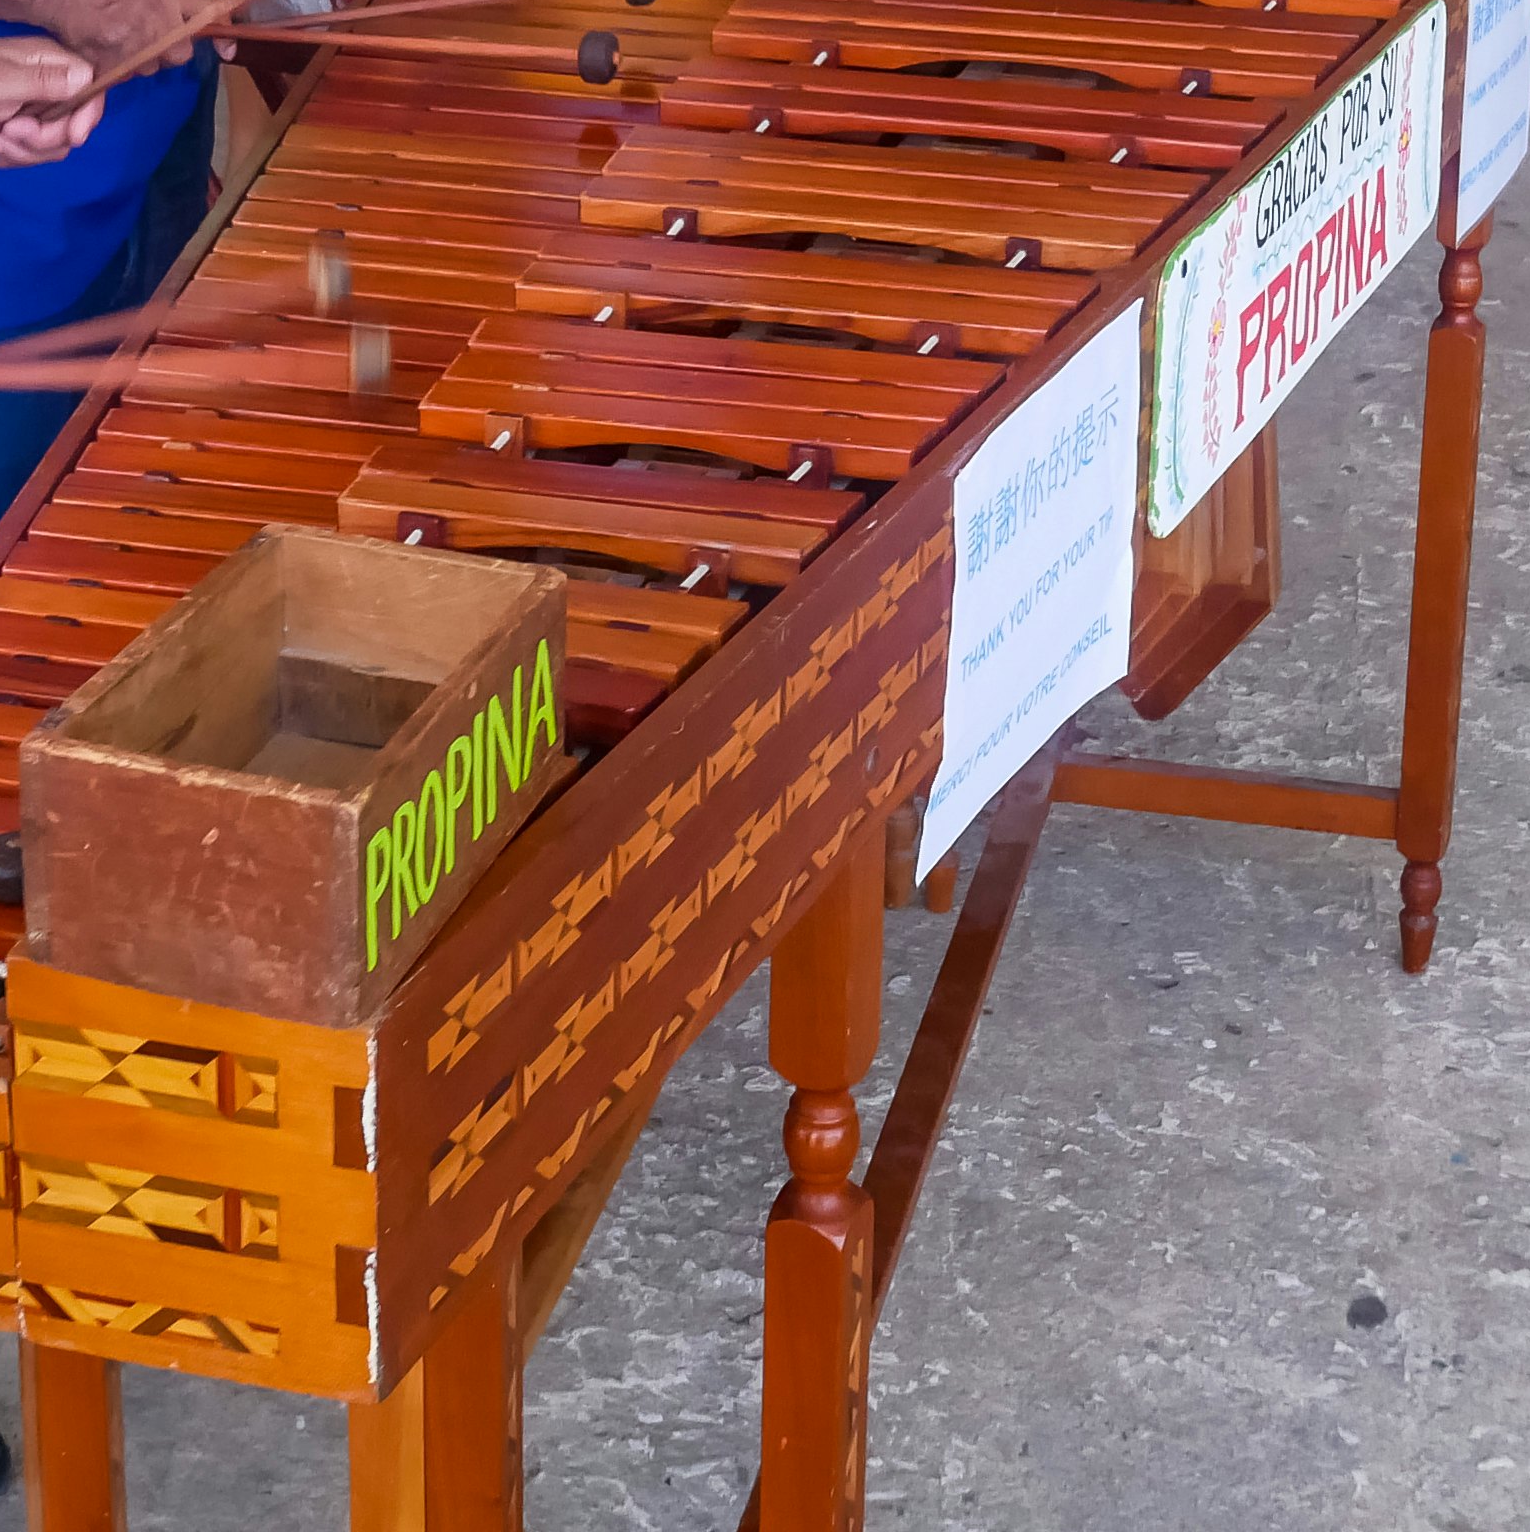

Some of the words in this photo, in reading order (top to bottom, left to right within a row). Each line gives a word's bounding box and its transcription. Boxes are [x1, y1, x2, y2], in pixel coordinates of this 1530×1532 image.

[1256, 113, 1328, 248] GRACIAS
[1340, 72, 1372, 164] POR
[1379, 42, 1399, 126] SU
[1233, 166, 1389, 432] PROPINA
[967, 383, 1120, 583] 謝謝你的提示
[960, 616, 1005, 682] THANK
[1009, 587, 1033, 633] YOU
[1035, 561, 1060, 605] FOR
[1063, 524, 1095, 577] YOUR
[1099, 504, 1114, 546] TIP
[365, 637, 557, 973] PROPINA
[929, 761, 971, 814] MERCI
[974, 712, 1013, 768] POUR
[1016, 666, 1059, 724] VOTRE
[1060, 612, 1112, 679] CONSEIL
